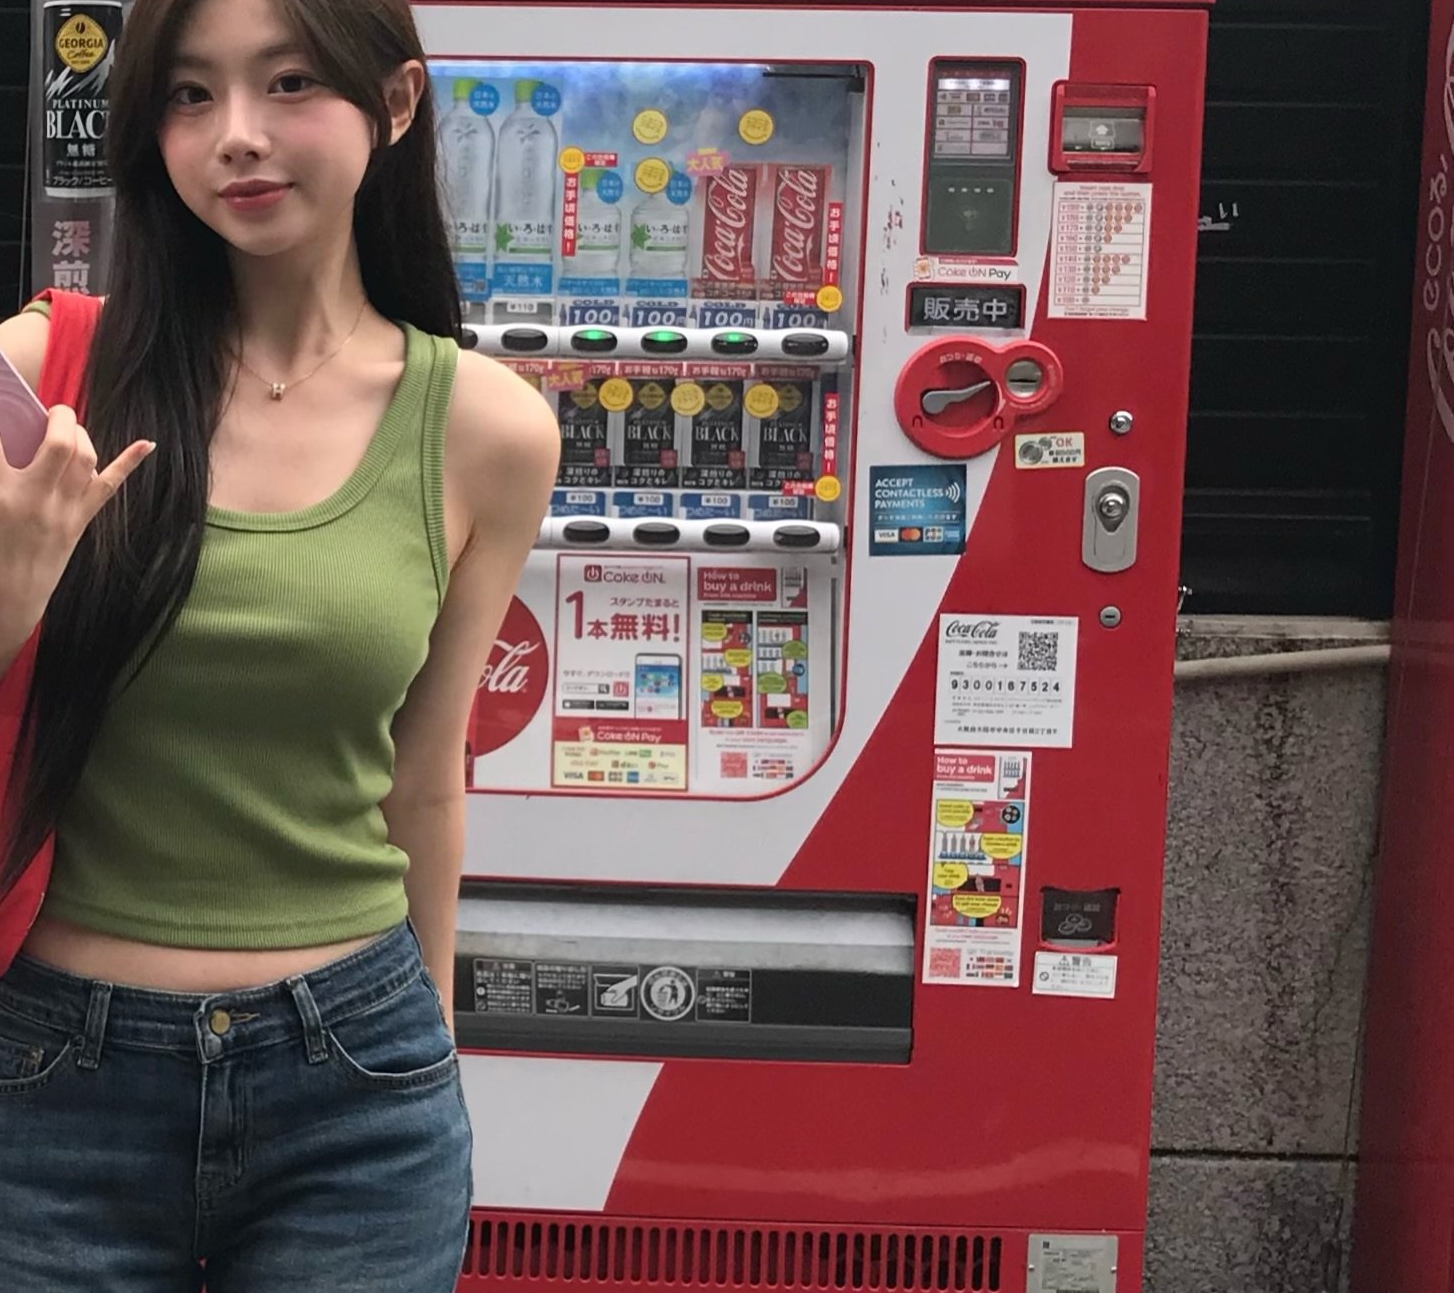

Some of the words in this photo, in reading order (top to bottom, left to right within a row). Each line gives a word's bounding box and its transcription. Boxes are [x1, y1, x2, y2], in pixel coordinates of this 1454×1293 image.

[58, 37, 104, 49] GEORGIA
[66, 143, 96, 158] 無糖
[937, 266, 967, 278] Coke
[968, 266, 987, 278] ON
[988, 266, 1011, 281] Pay
[509, 303, 534, 312] ¥110
[636, 300, 679, 308] COLD
[923, 297, 1008, 322] 販売中
[561, 424, 606, 440] BLACK
[627, 425, 672, 440] BLACK
[695, 426, 740, 442] BLACK
[763, 427, 808, 443] BLACK
[1056, 437, 1074, 448] OK
[875, 478, 914, 487] ACCEPT
[874, 488, 944, 498] CONTACTLESS
[874, 499, 926, 509] PAYMENTS
[603, 570, 640, 584] Coke
[641, 571, 665, 585] ON
[703, 571, 728, 581] How
[729, 572, 740, 581] to
[703, 581, 726, 594] buy
[729, 584, 738, 592] a
[740, 581, 772, 593] drink
[609, 596, 680, 609] スタンプたまると
[596, 730, 623, 742] Coke
[641, 732, 662, 744] Pay
[936, 756, 957, 766] How
[957, 756, 969, 766] to
[936, 765, 956, 776] buy
[957, 766, 965, 774] a
[966, 765, 993, 776] drink
